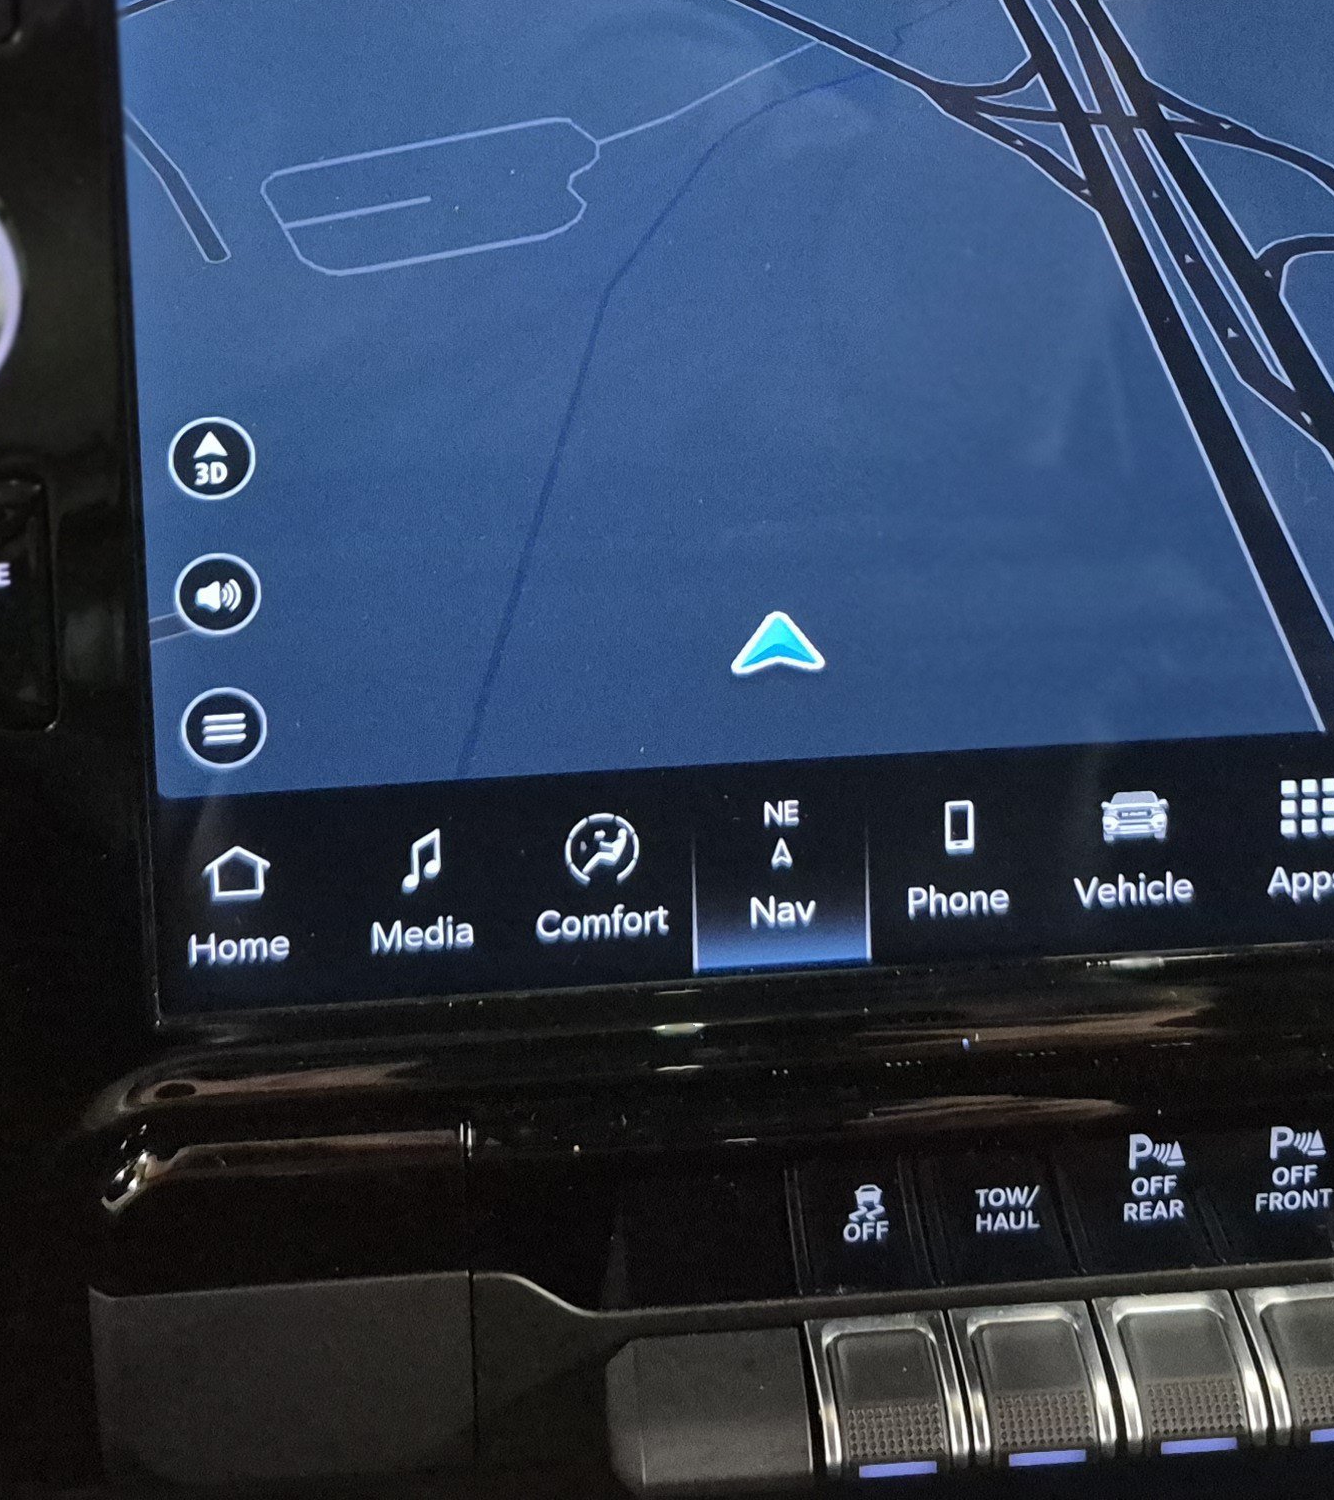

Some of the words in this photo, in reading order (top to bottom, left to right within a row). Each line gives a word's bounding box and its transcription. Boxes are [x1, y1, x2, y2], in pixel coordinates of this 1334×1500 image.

[194, 461, 228, 486] 3D
[763, 799, 800, 827] NE
[907, 886, 1010, 920] Phone
[1074, 871, 1195, 910] Vehicle
[536, 903, 670, 944] Comfort
[750, 896, 816, 929] Nav
[370, 914, 475, 956] Media
[188, 932, 291, 967] Home
[1131, 1174, 1178, 1198] OFF
[1271, 1164, 1319, 1188] OFF
[974, 1184, 1041, 1210] TOW/
[1123, 1198, 1185, 1223] REAR
[1255, 1186, 1334, 1213] FRONT
[842, 1220, 889, 1243] OFF
[975, 1210, 1041, 1234] HAUL
